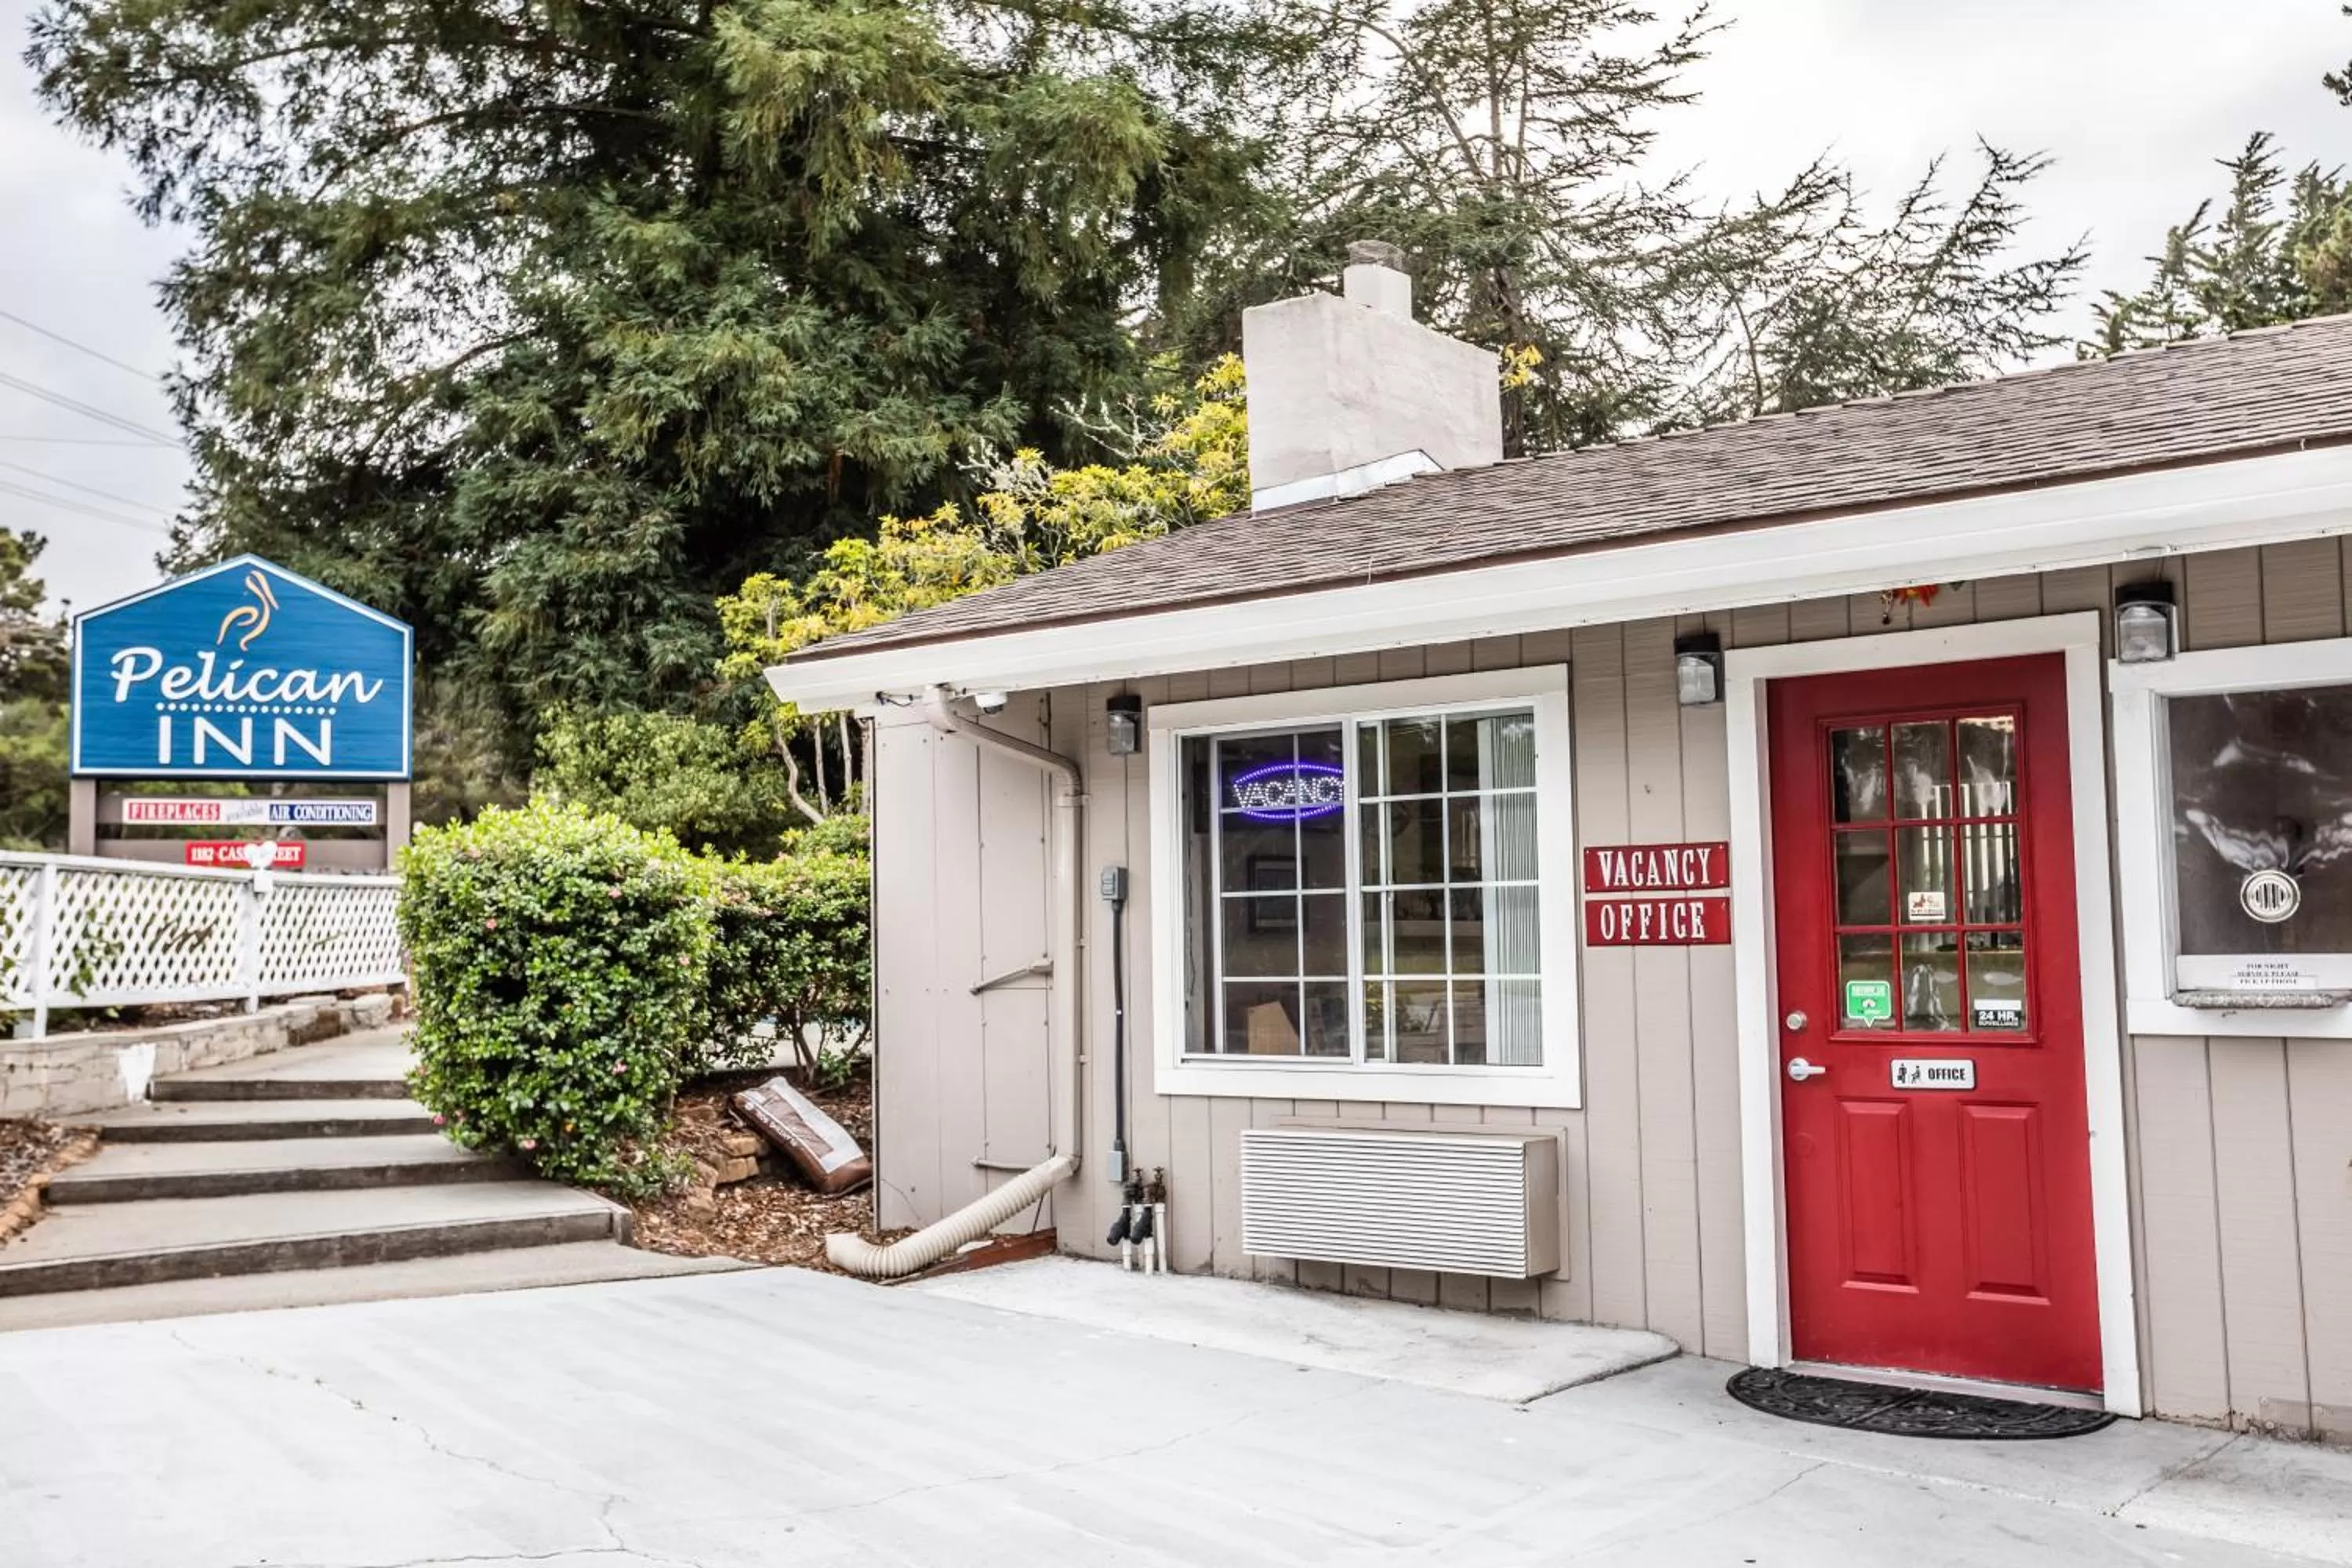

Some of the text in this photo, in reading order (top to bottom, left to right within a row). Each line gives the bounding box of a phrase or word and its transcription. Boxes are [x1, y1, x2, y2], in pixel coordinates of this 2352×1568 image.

[111, 647, 383, 703] Pelican
[158, 715, 332, 766] INN
[131, 804, 219, 820] FIREPLACES
[270, 805, 290, 820] AIR
[293, 805, 372, 821] CONDITIONING
[1597, 848, 1712, 887] VACANCY
[1600, 902, 1706, 940] OFFICE
[1978, 1011, 2020, 1022] 24 HR.
[1928, 1067, 1966, 1080] OFFICE
